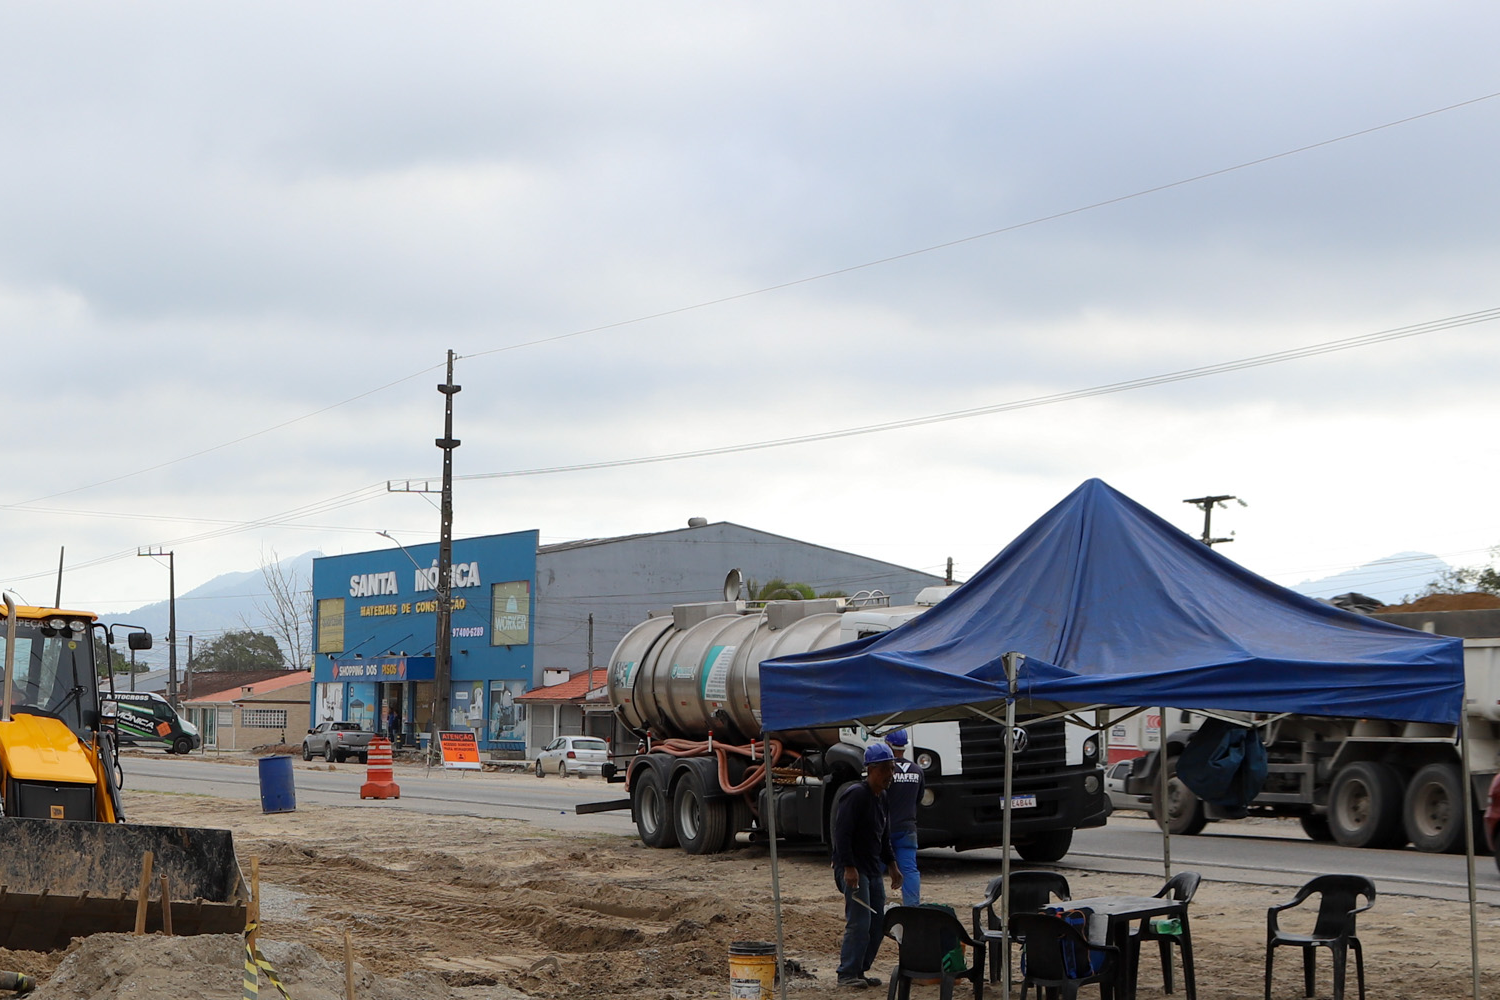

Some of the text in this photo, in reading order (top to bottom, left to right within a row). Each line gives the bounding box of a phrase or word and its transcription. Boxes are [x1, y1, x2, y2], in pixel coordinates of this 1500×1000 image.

[349, 559, 481, 597] SANTA MÔICA
[361, 596, 466, 617] MATERIAIS DE CONSTÇÃO
[495, 615, 527, 631] WORKER
[339, 664, 397, 677] SHOPPING DOS PISOS
[442, 733, 473, 741] ATENÇÃO
[893, 772, 919, 780] VIAFER
